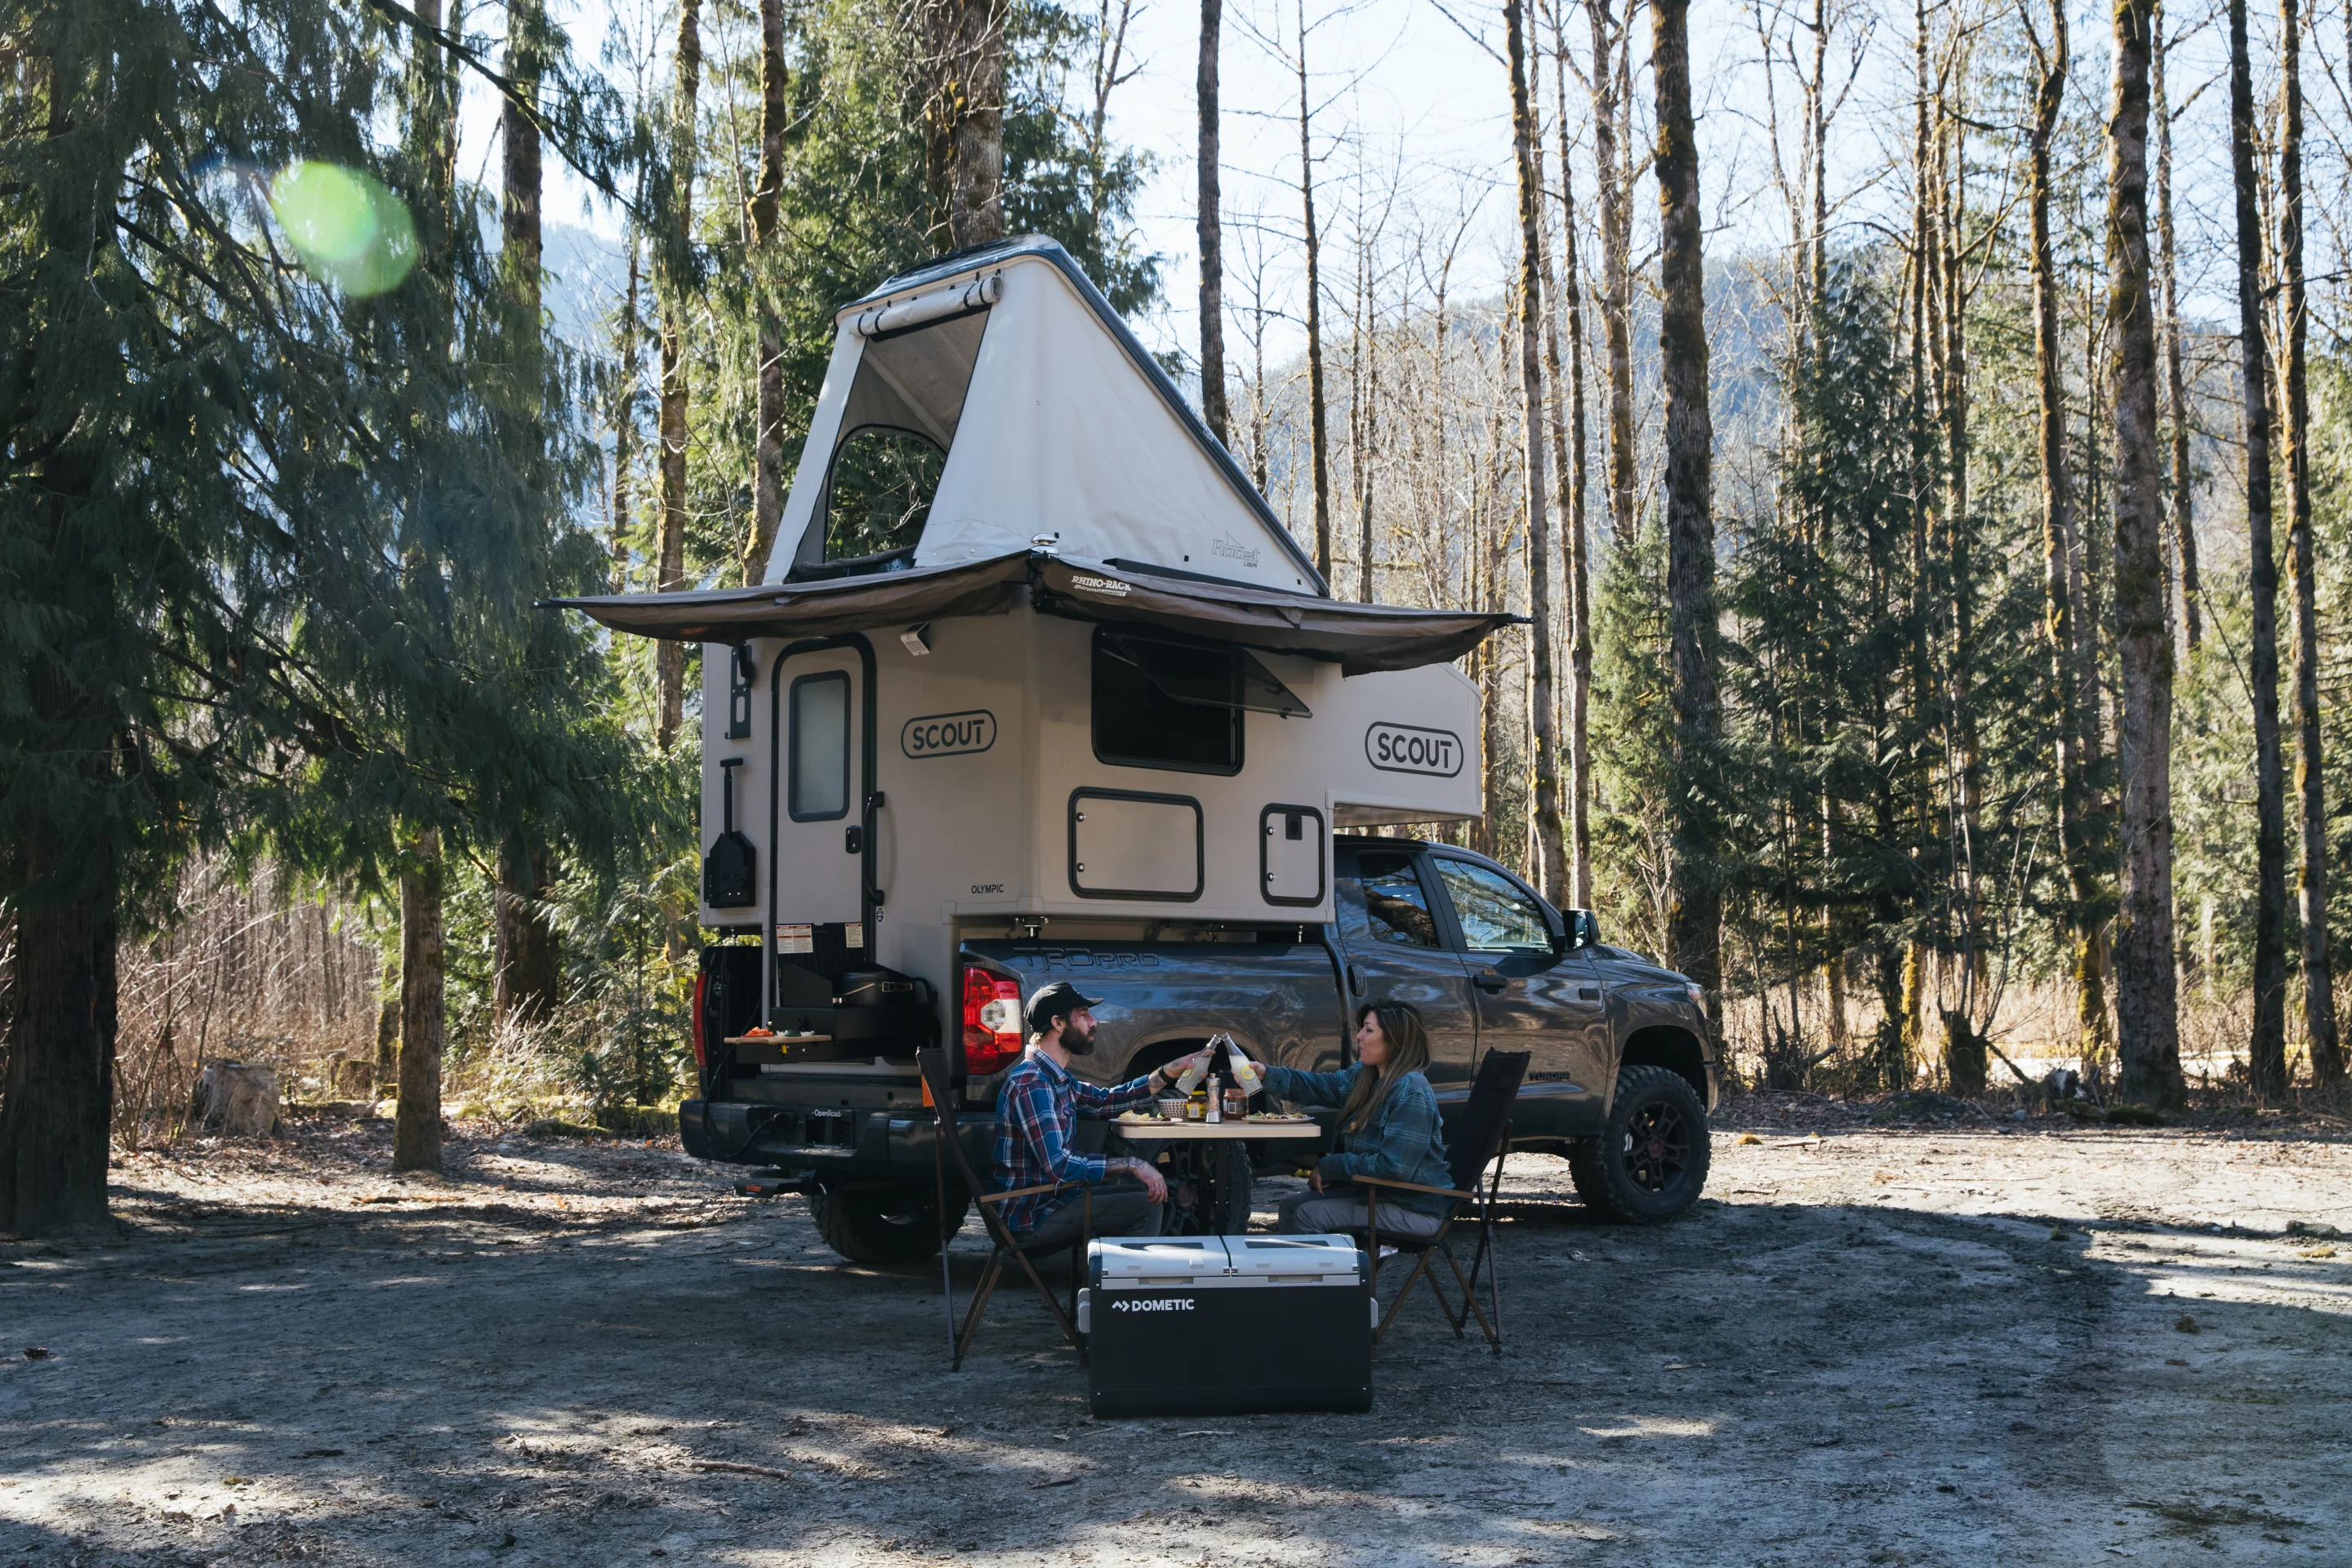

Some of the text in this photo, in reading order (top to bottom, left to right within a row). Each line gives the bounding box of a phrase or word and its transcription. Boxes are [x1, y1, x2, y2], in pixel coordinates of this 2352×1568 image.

[1212, 539, 1261, 563] Roost
[1071, 576, 1131, 590] RHINO-RACK
[912, 719, 985, 751] SCOUT
[1378, 732, 1452, 768] SCOUT
[971, 884, 1004, 893] OLYMPIC
[1529, 1071, 1570, 1080] TUNDRA
[814, 1109, 841, 1117] OpenRoad
[1131, 1298, 1195, 1312] DOMETIC
